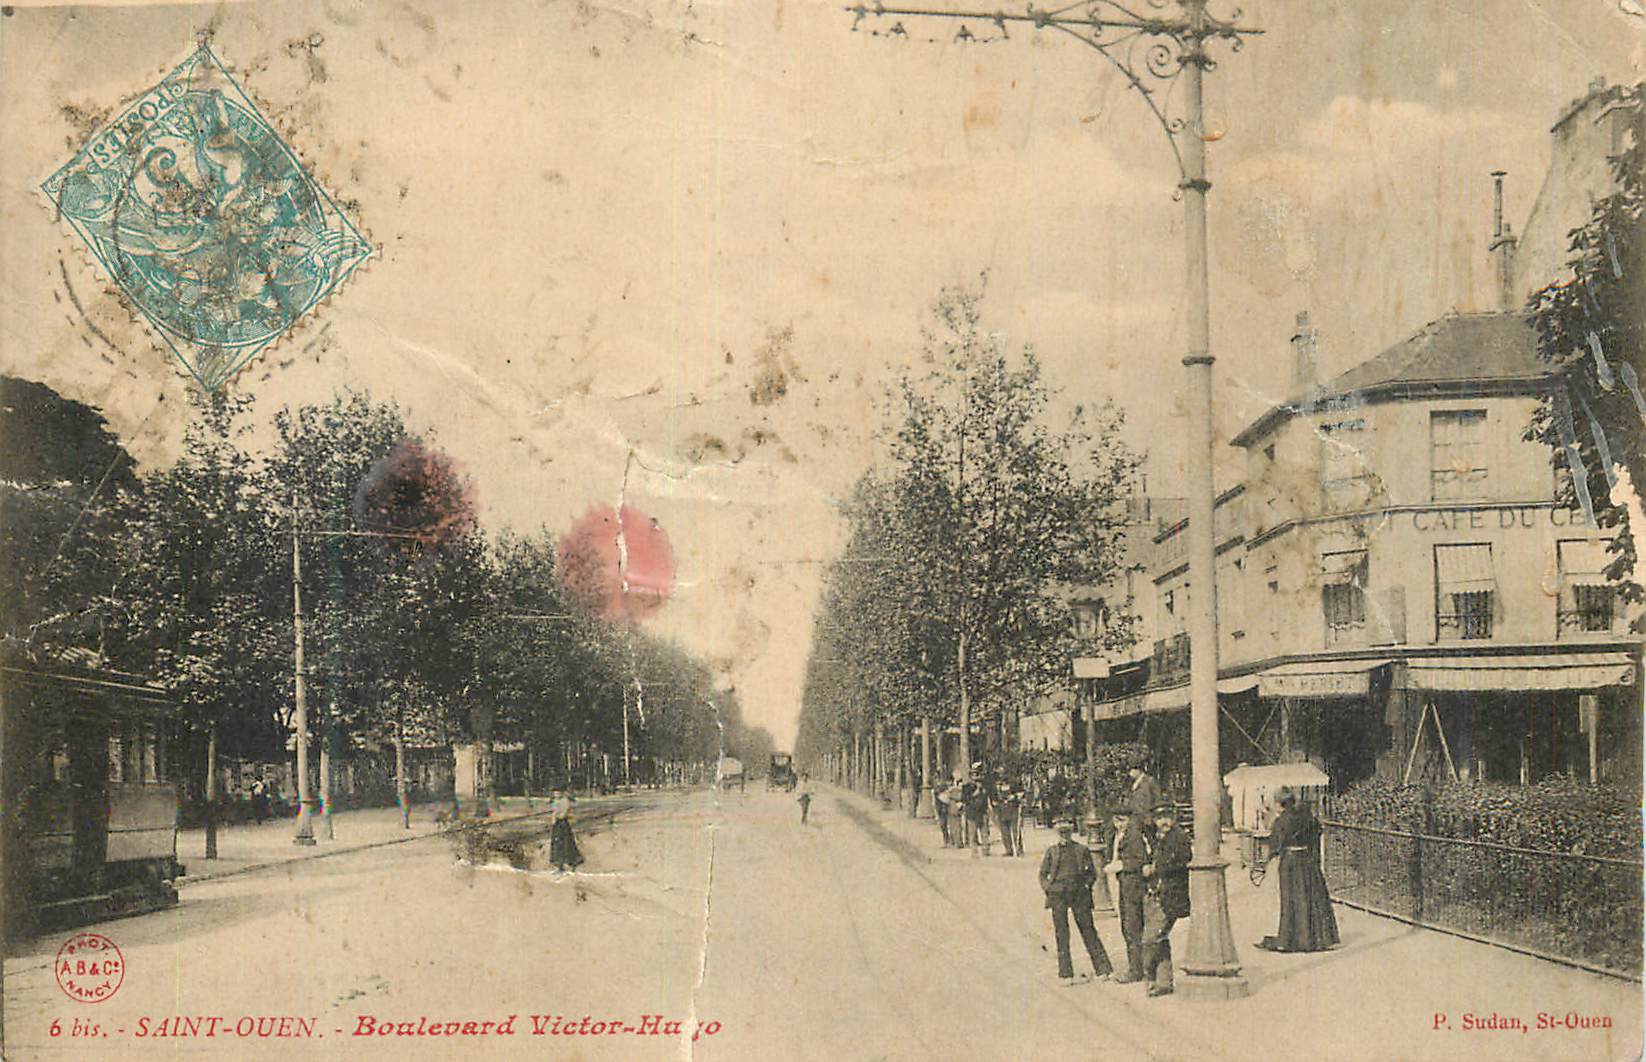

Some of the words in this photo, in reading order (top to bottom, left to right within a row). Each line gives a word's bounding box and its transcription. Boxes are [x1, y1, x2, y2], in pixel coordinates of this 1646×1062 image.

[93, 91, 171, 163] POSTES
[1412, 508, 1484, 531] CAFE
[1499, 506, 1535, 529] DU
